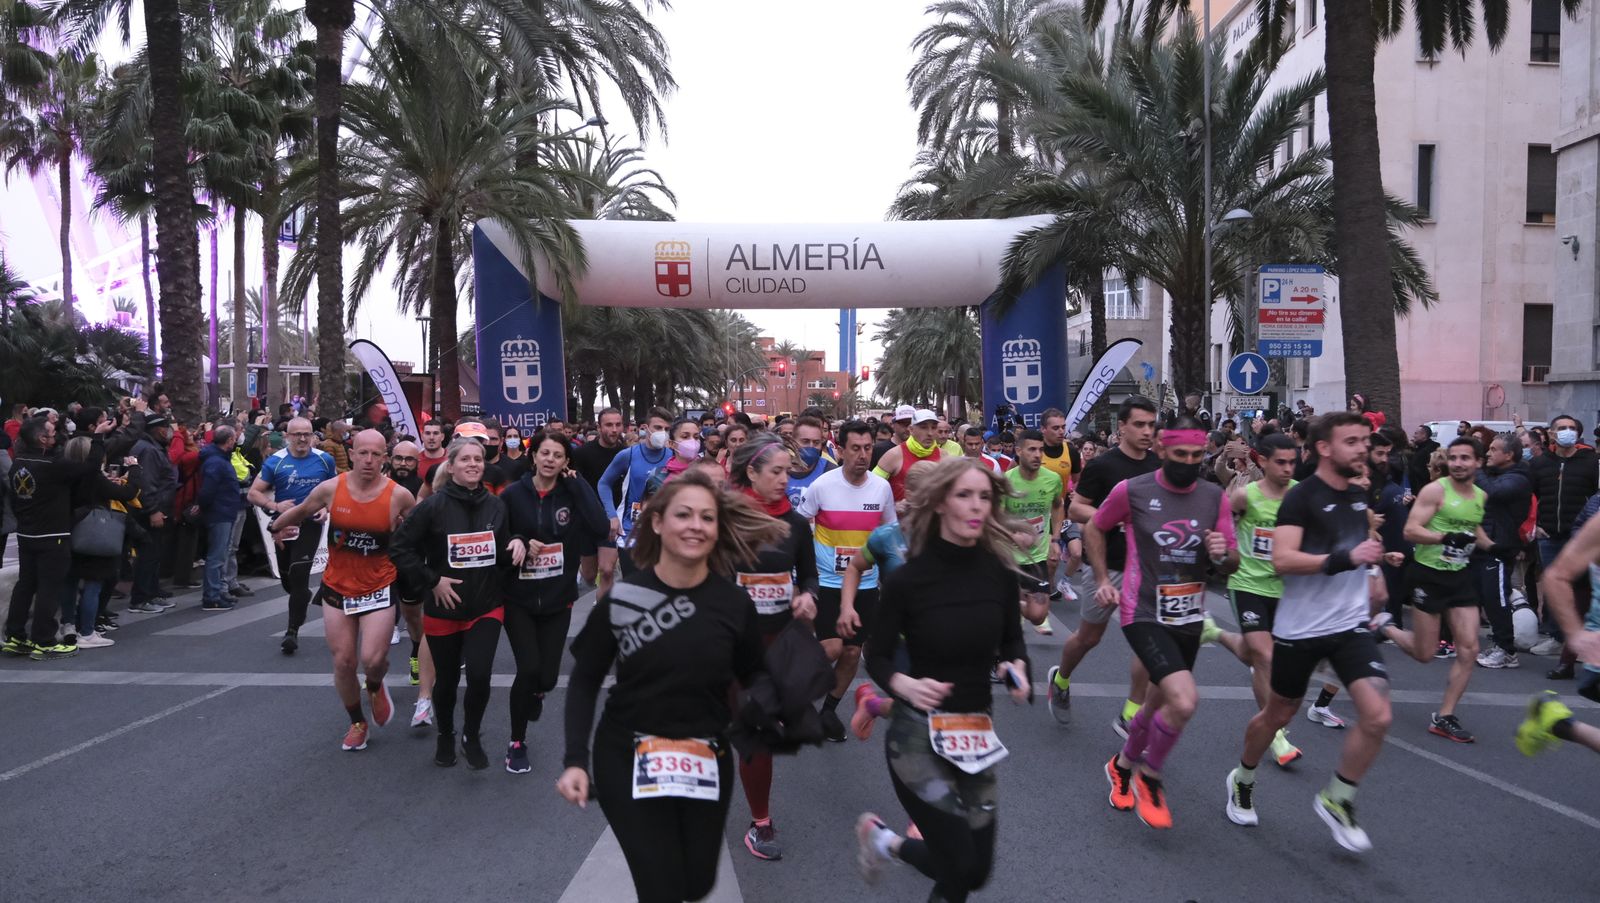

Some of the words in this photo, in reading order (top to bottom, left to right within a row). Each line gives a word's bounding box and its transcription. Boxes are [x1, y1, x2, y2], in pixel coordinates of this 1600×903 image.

[725, 237, 885, 270] ALMERÍA
[725, 277, 807, 294] CIUDAD
[1264, 279, 1280, 297] P
[862, 503, 880, 511] 226ERS
[458, 543, 490, 556] 3304
[616, 595, 696, 661] didas
[943, 734, 988, 752] 3374
[649, 755, 704, 776] 3361
